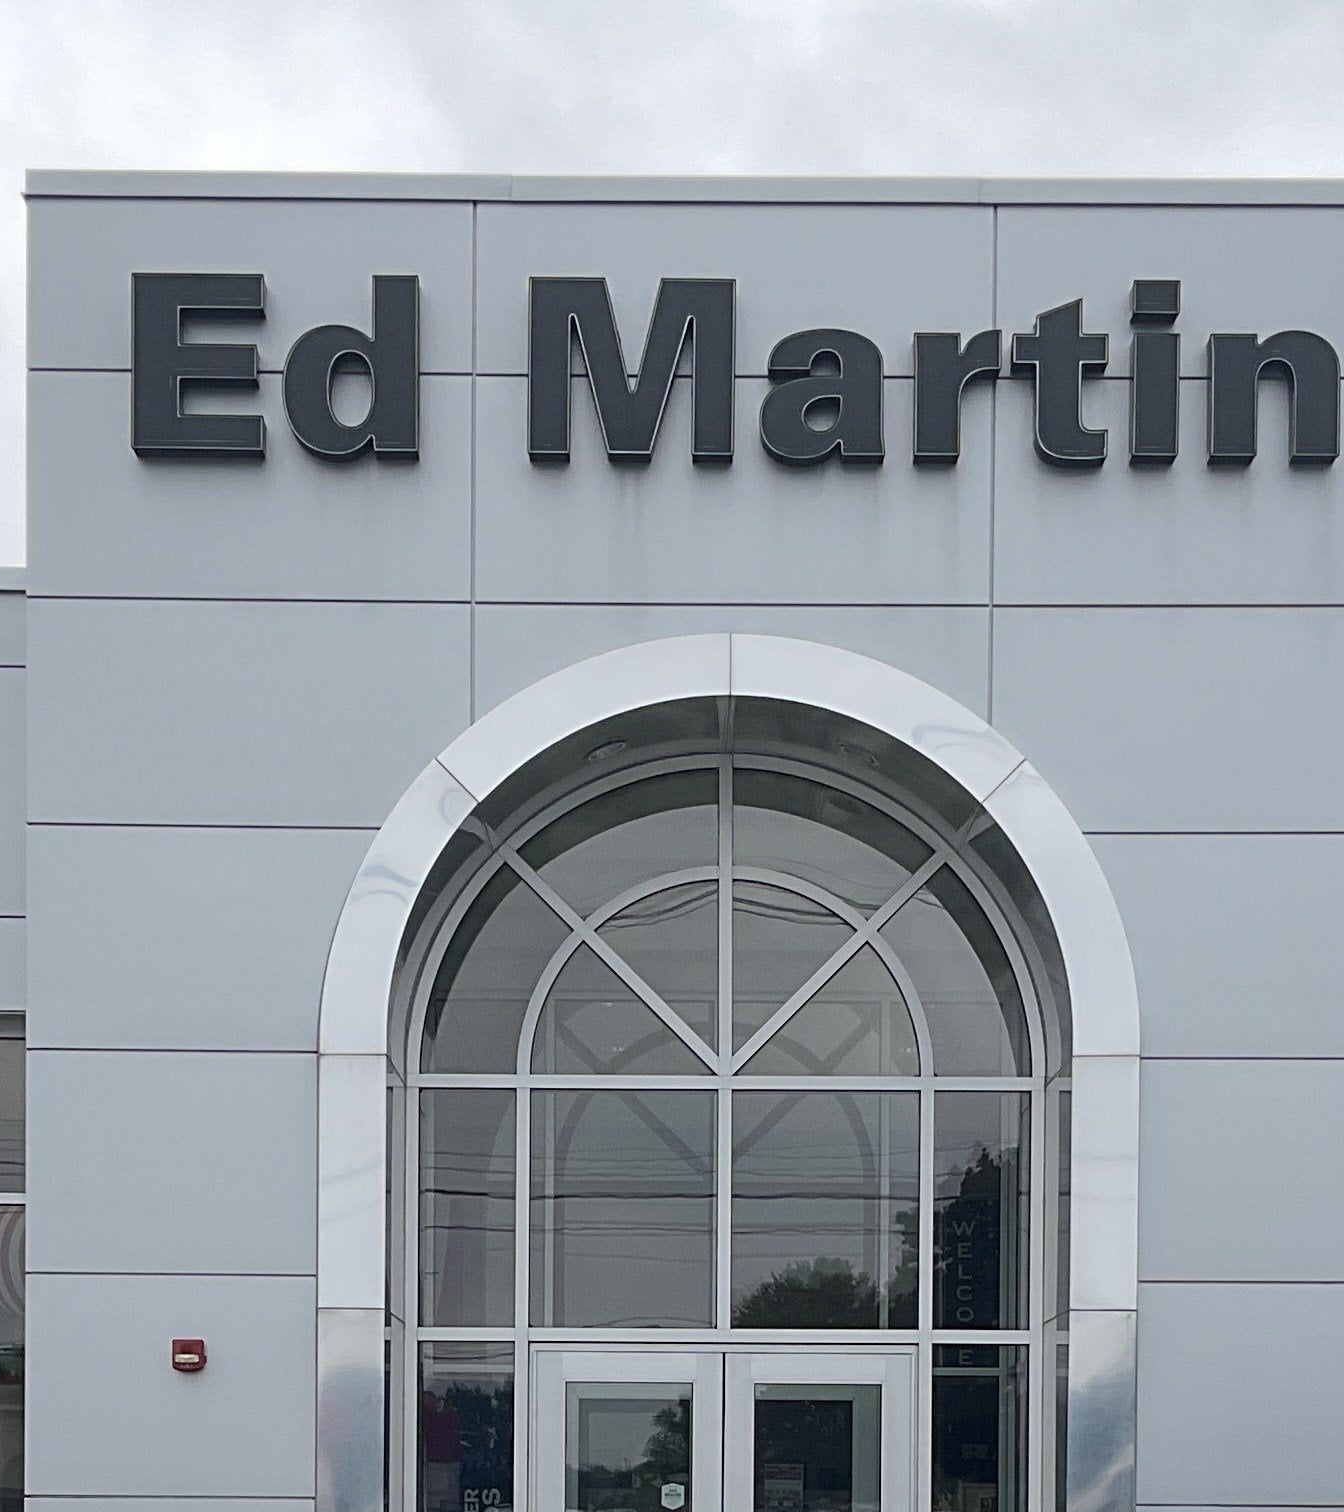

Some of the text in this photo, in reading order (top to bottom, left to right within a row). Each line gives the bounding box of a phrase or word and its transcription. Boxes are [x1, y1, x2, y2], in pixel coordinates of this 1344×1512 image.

[131, 272, 1342, 467] Ed Martin
[952, 1221, 976, 1366] WELCOE
